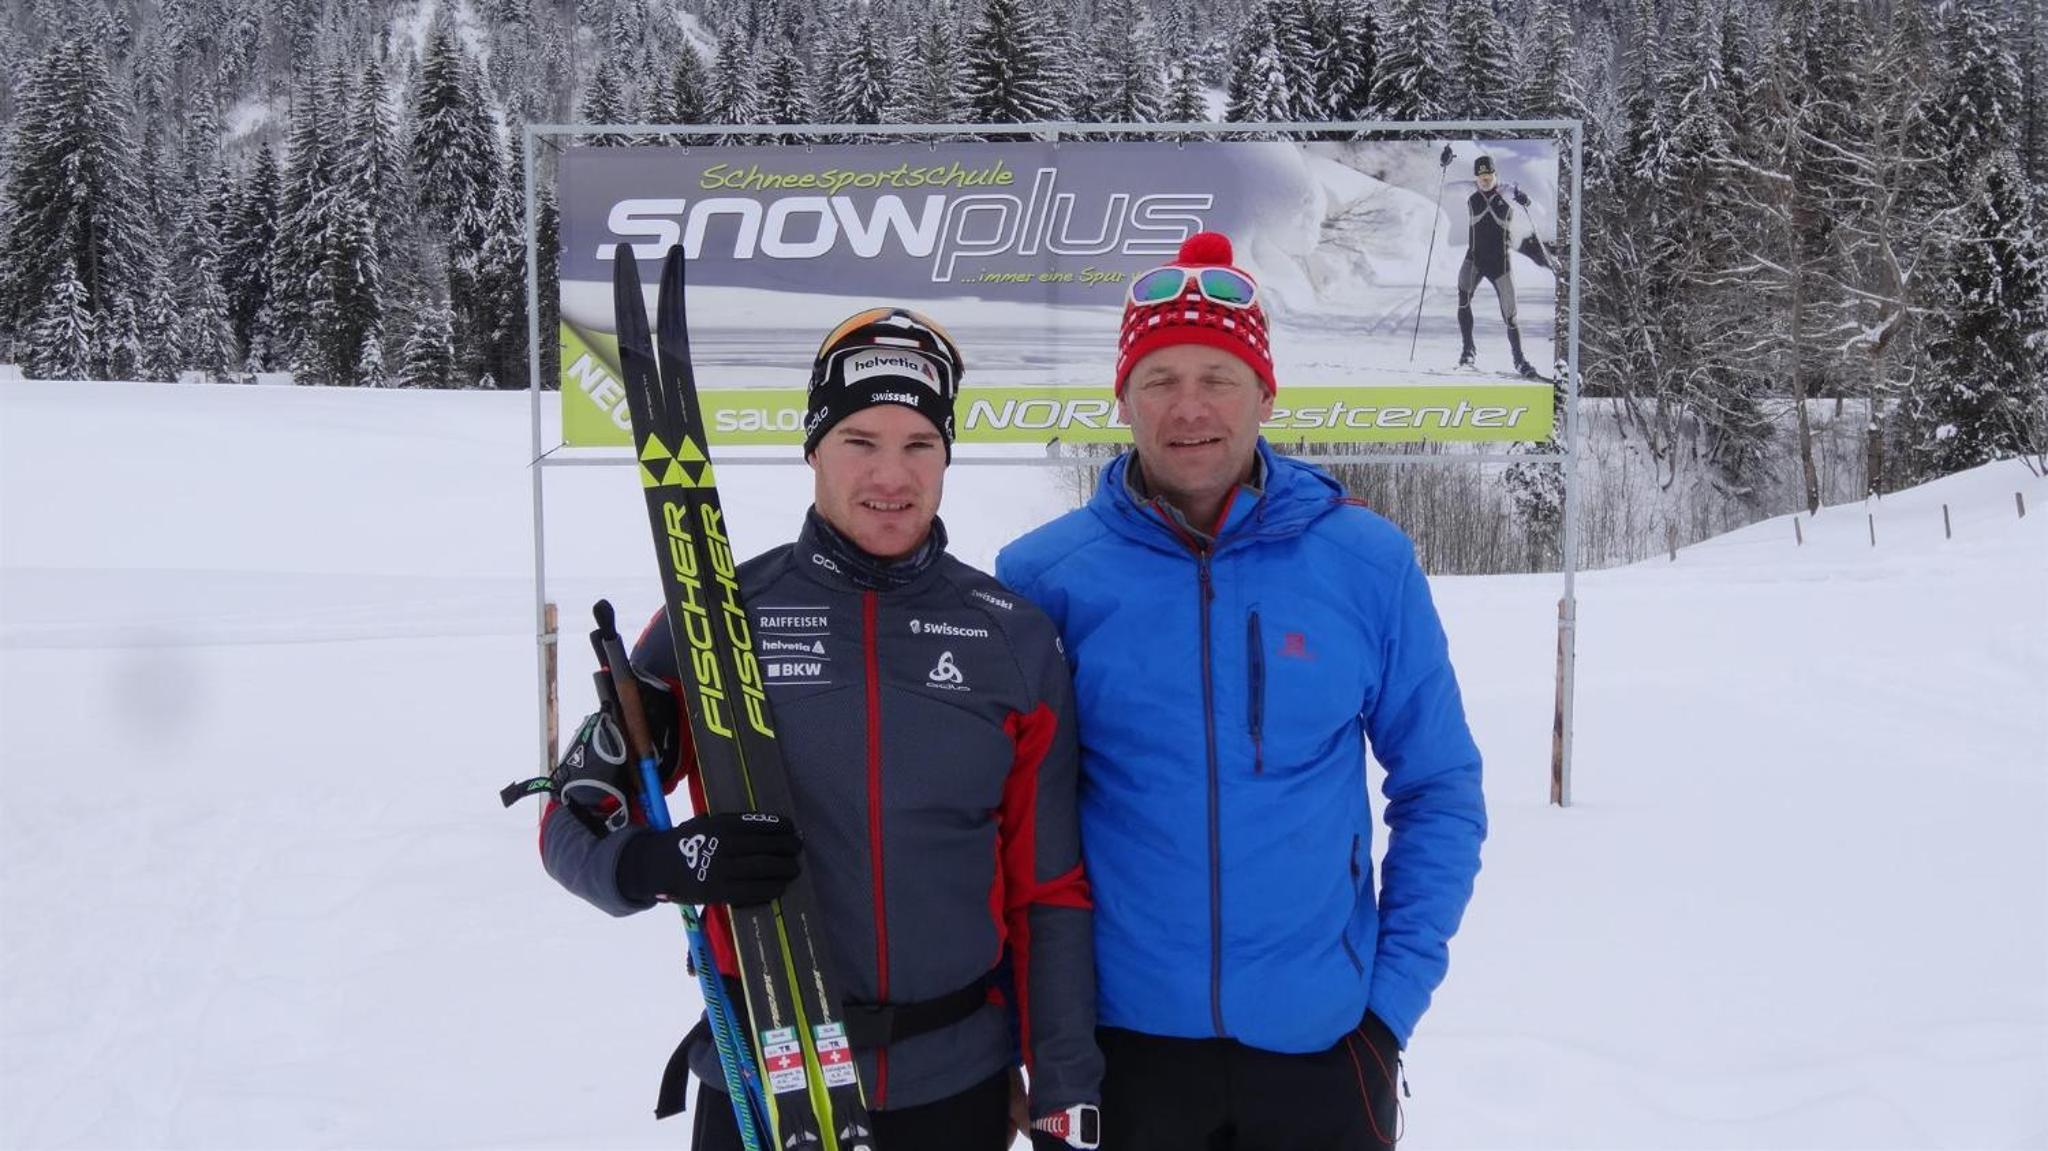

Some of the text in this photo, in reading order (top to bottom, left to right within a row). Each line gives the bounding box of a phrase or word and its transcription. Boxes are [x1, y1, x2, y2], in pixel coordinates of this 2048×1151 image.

[701, 160, 1014, 195] Schneesportschule
[1038, 267, 1073, 282] eine
[1078, 265, 1125, 287] Spur
[855, 356, 919, 372] helvetia
[714, 407, 808, 433] salo
[1259, 400, 1528, 429] estcenter
[663, 501, 733, 738] FISCHER
[700, 503, 775, 738] FISCHER
[760, 616, 828, 628] RAIFFEISEN
[923, 622, 989, 639] swisscom
[762, 640, 811, 652] helvetia
[782, 663, 821, 676] BKW
[742, 813, 779, 823] odlo
[697, 836, 719, 881] odlo
